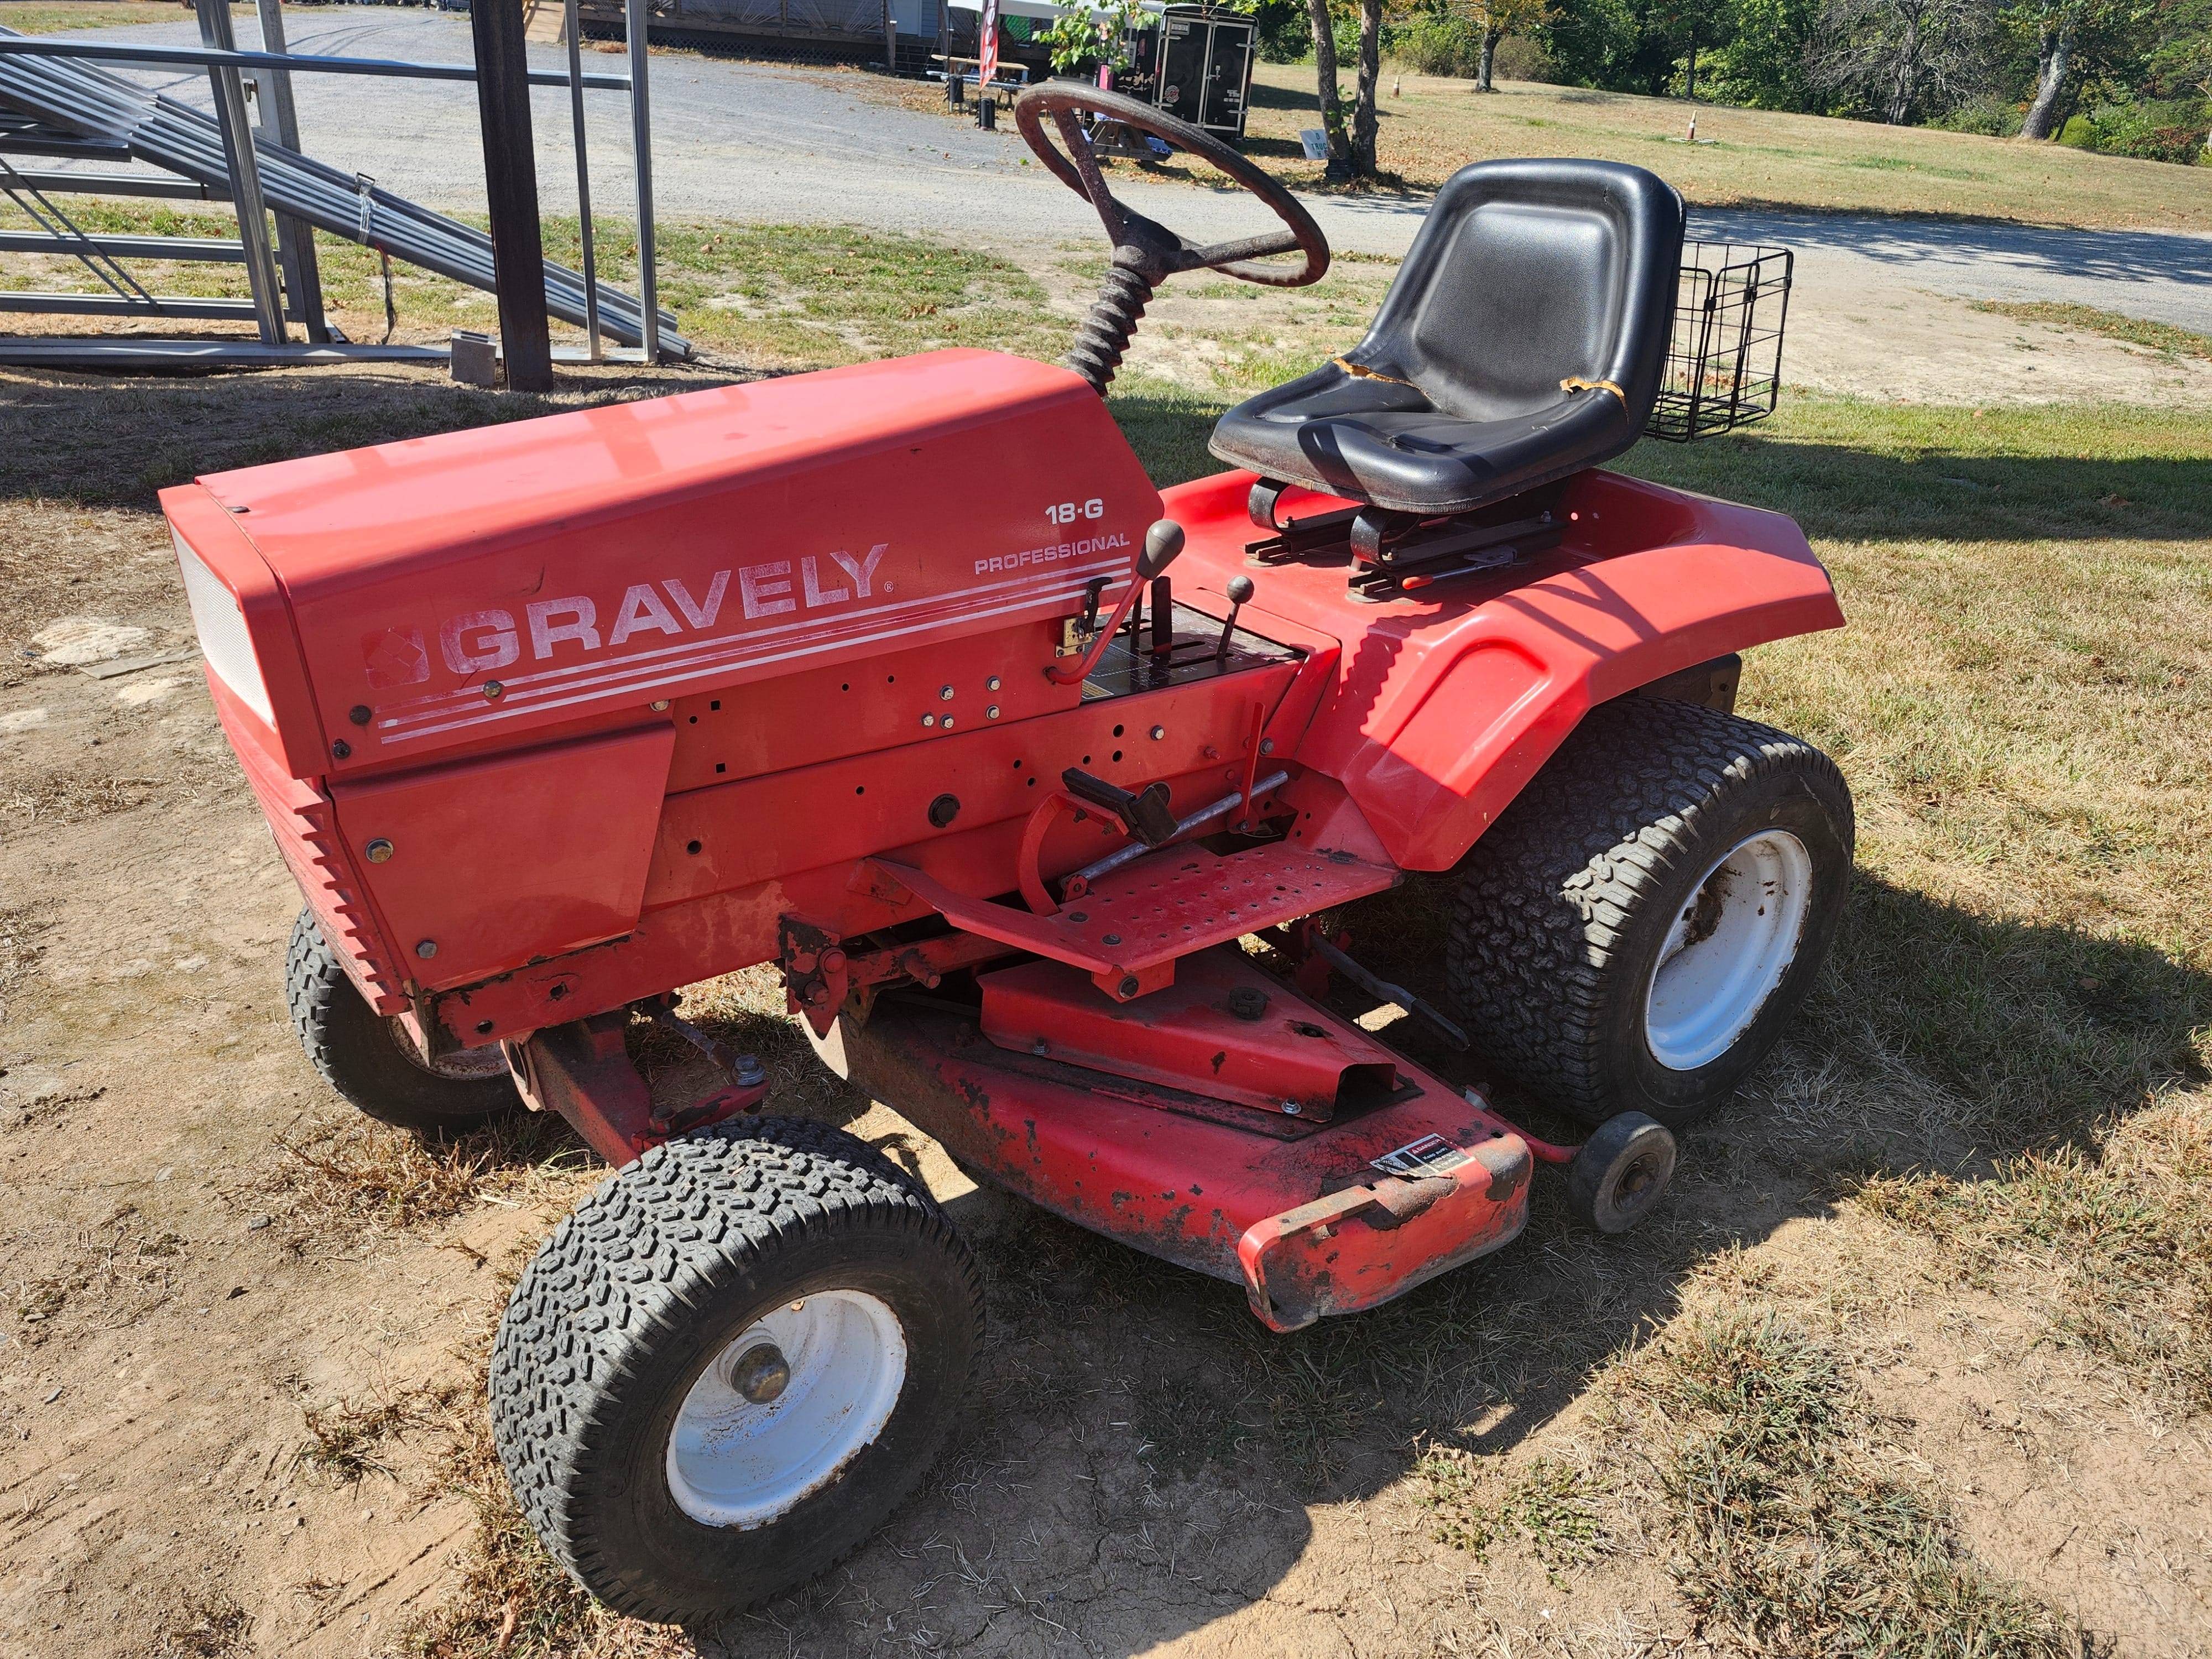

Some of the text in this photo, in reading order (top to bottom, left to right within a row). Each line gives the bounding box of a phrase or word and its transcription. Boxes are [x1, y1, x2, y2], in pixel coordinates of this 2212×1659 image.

[974, 533, 1130, 575] PROFESSIONAL
[440, 543, 889, 674] GRAVELY
[1416, 1139, 1441, 1151] DANGER
